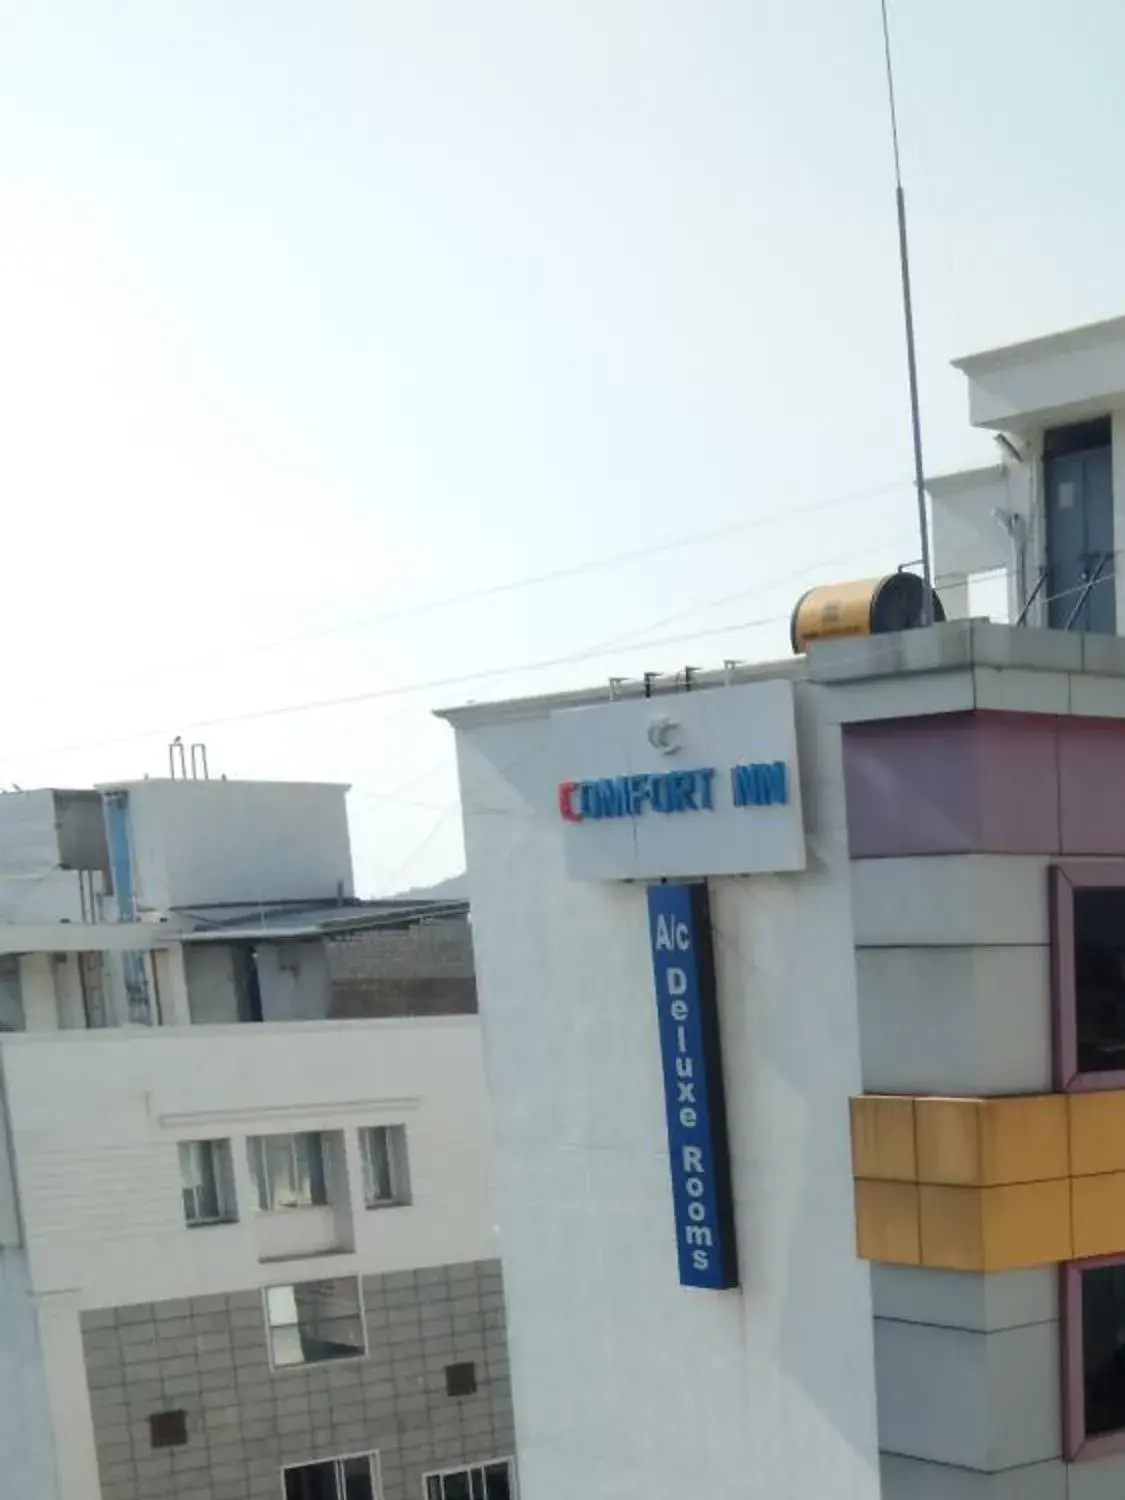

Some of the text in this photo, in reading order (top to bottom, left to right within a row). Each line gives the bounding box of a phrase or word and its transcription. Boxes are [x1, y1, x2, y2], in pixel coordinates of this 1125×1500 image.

[558, 761, 787, 824] COMFORT INN
[666, 966, 697, 1128] Deluxe
[682, 1145, 713, 1271] Rooms
